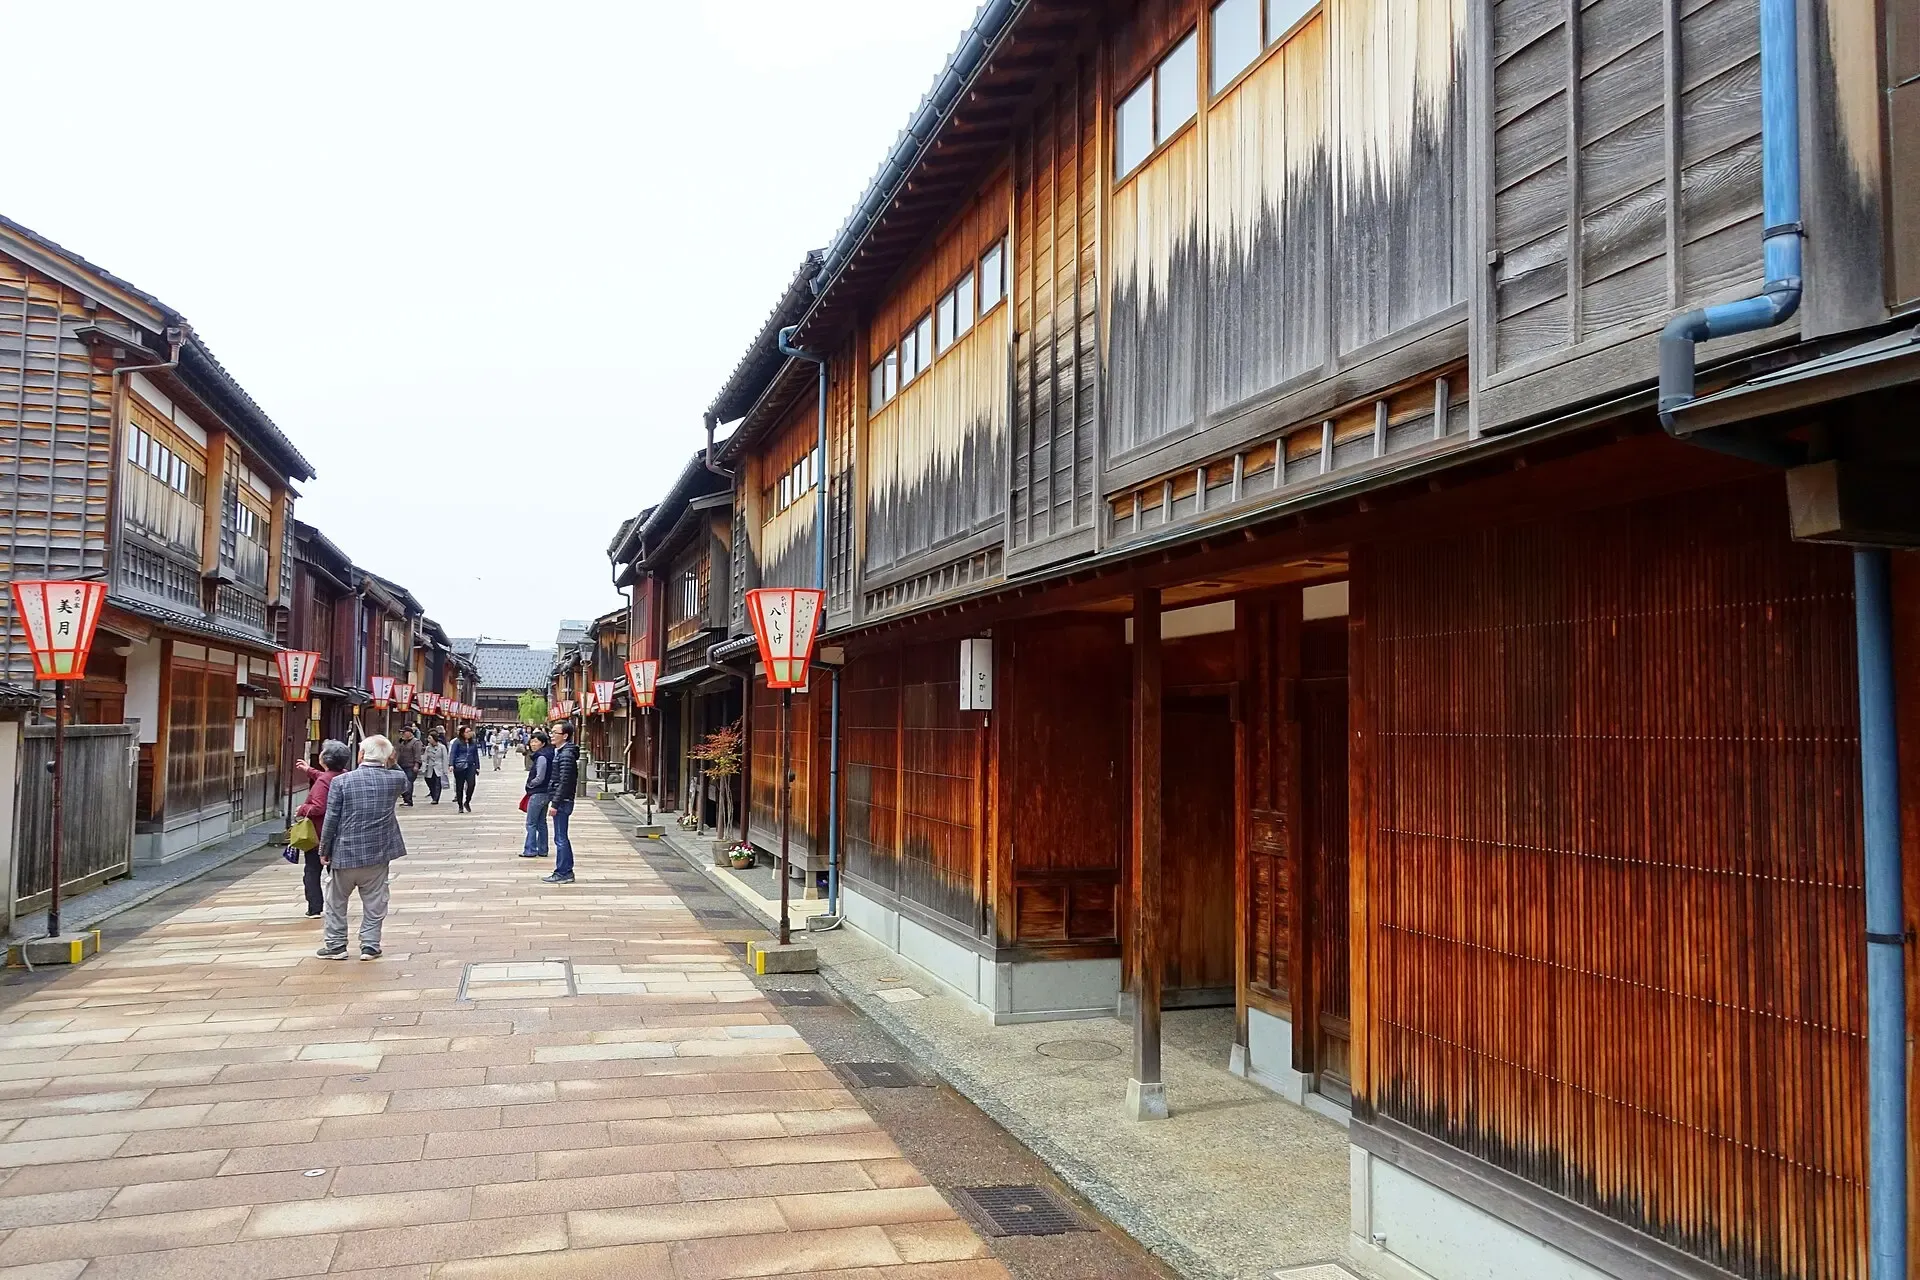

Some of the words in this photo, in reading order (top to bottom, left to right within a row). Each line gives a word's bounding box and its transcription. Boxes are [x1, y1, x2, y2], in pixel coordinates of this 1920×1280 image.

[57, 599, 73, 635] 美月
[770, 607, 784, 644] 八しげ
[978, 672, 986, 703] ひがし
